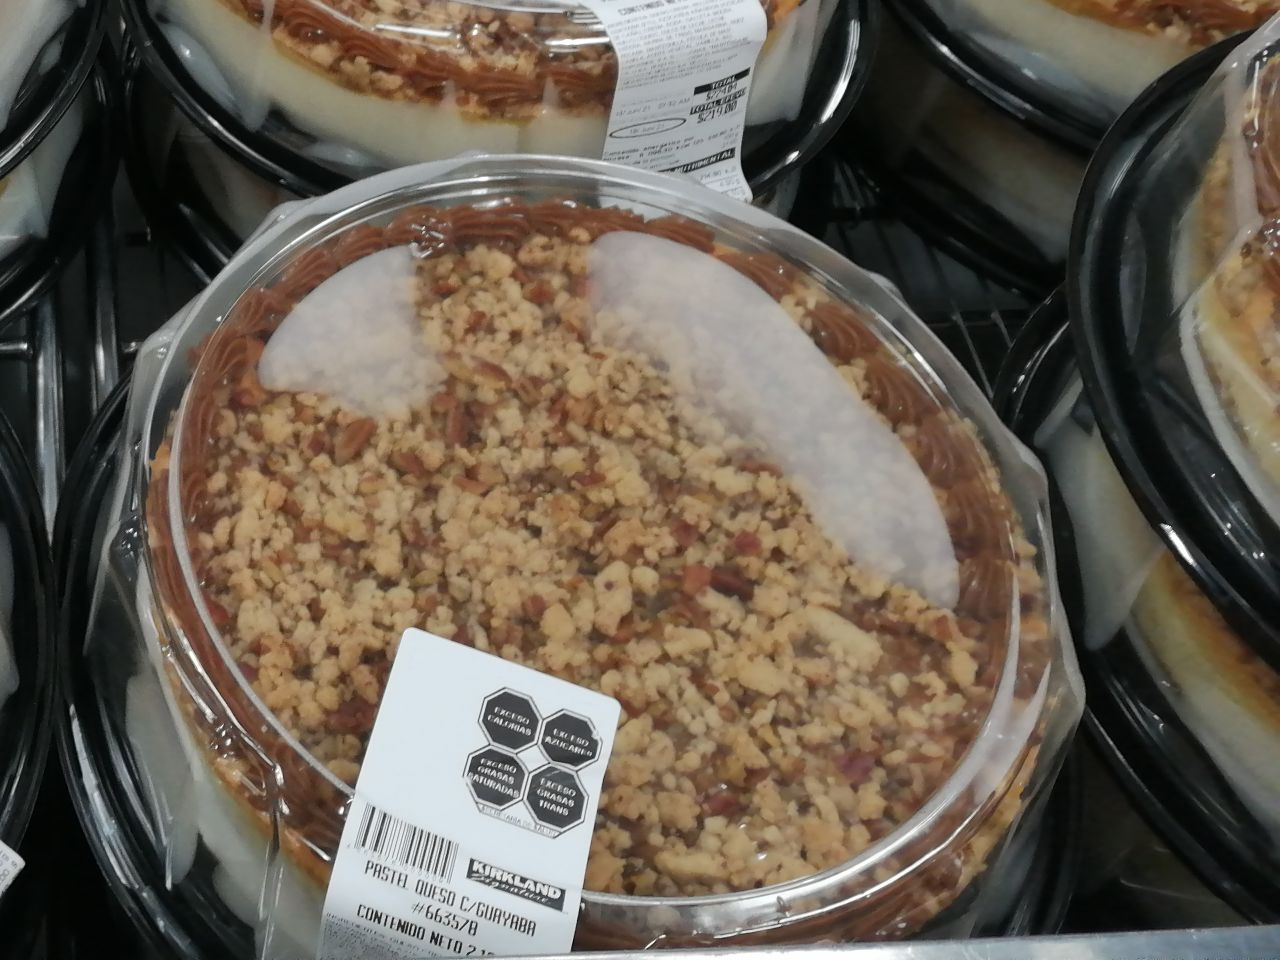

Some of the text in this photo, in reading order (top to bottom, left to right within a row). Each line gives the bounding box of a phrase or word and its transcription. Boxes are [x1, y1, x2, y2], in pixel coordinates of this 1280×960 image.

[486, 714, 532, 736] CALORIAS
[493, 706, 529, 725] EXCESO
[552, 728, 589, 747] EXCESO
[476, 765, 515, 784] GRASAS
[479, 757, 517, 773] EXCESO
[467, 771, 520, 798] SATURADAS
[539, 777, 577, 797] EXCESO
[536, 787, 575, 807] GRASAS
[538, 799, 569, 816] TRANS
[469, 871, 549, 905] Signature
[471, 859, 562, 900] KIRKLAND
[363, 860, 411, 890] PASTEL
[414, 880, 456, 907] QUESO
[458, 896, 537, 936] C/GUAYABA
[410, 900, 479, 936] #663578
[356, 904, 426, 940] CONTENIDO
[429, 930, 463, 954] NETO
